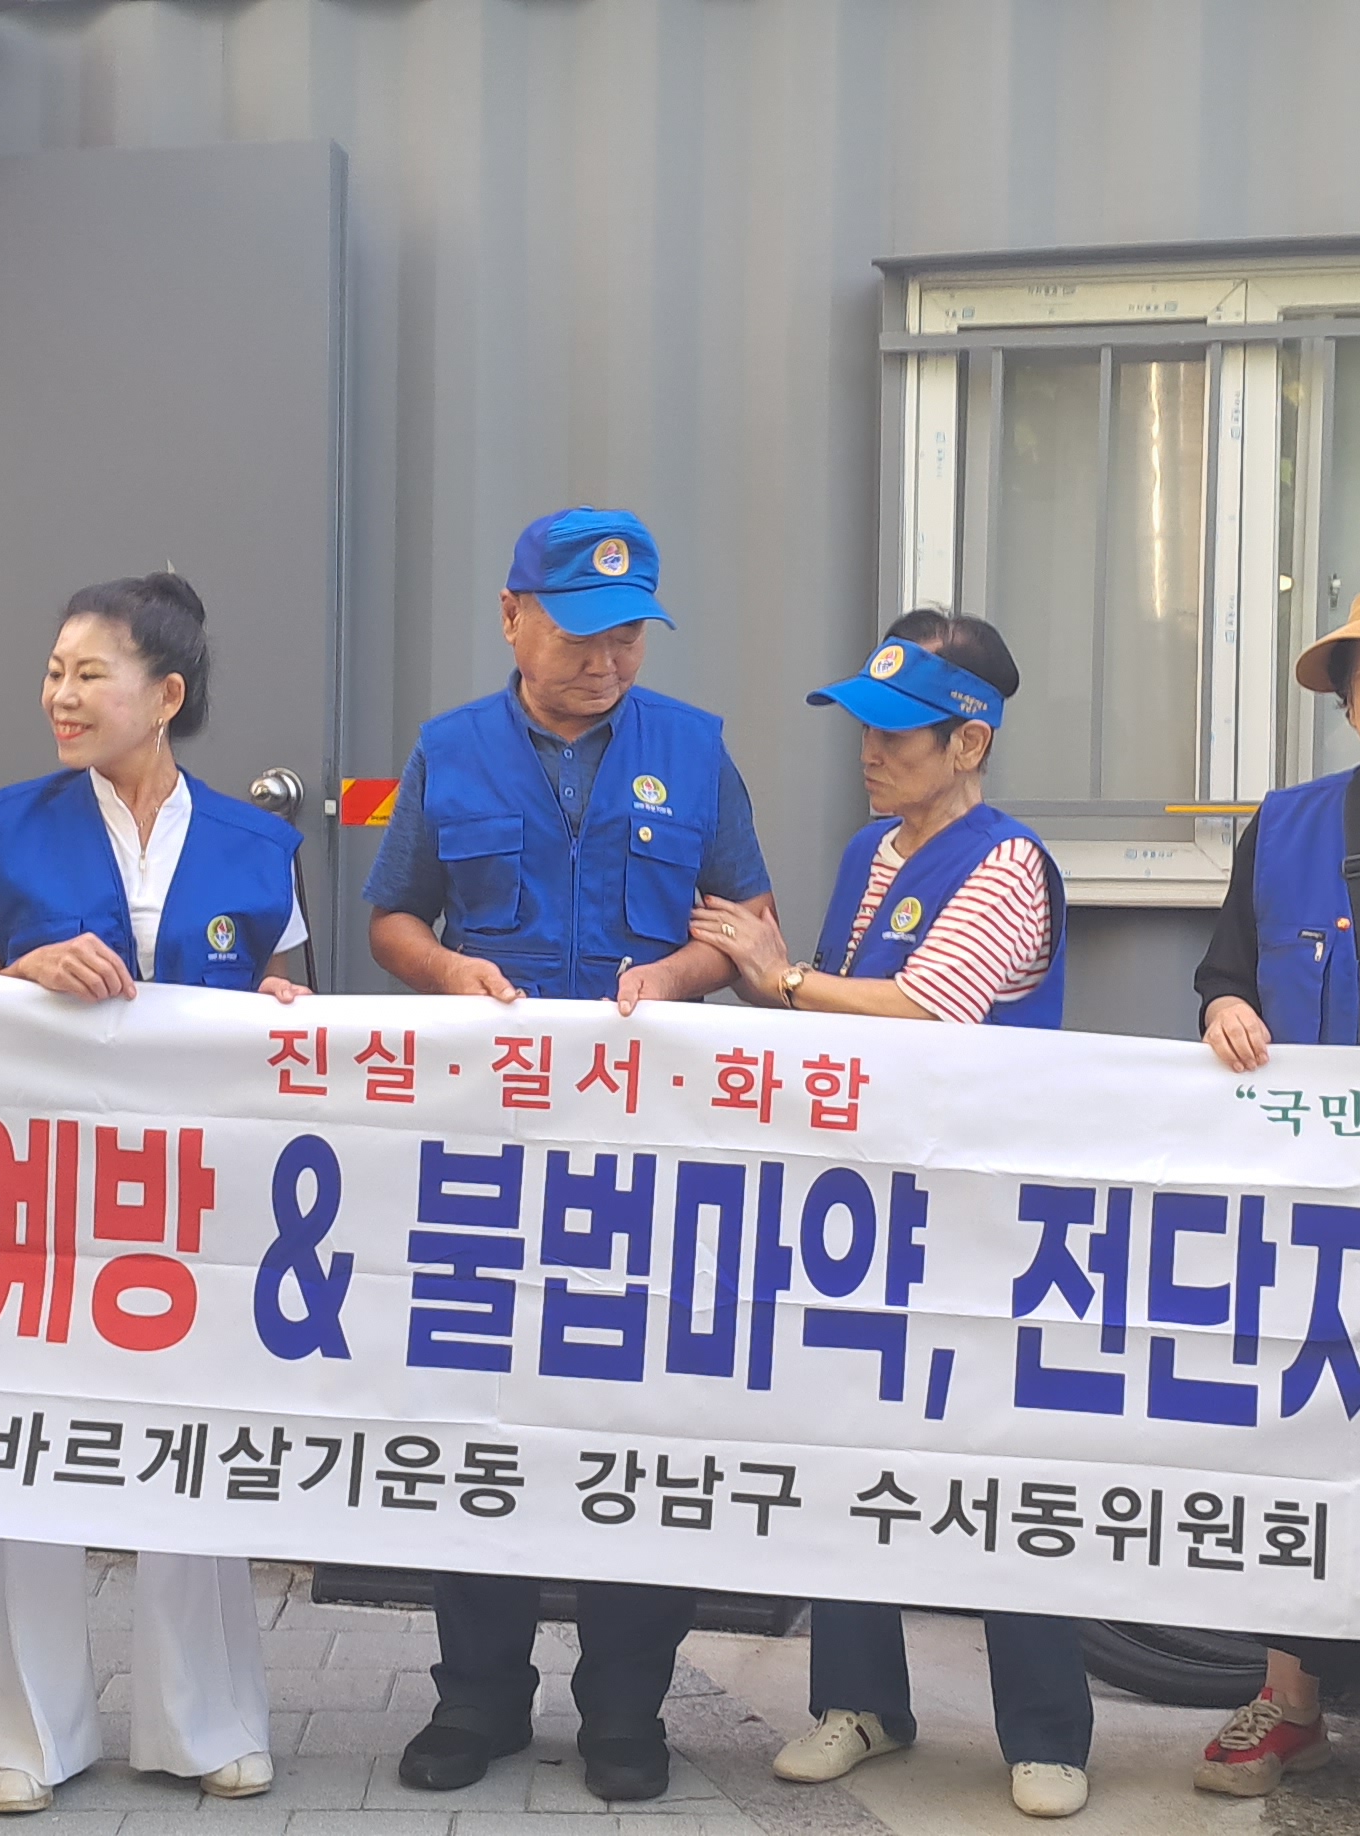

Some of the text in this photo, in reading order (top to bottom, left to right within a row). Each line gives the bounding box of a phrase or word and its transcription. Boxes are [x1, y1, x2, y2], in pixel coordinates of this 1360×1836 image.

[253, 1134, 355, 1361] &
[407, 1140, 955, 1420] 불법마약,
[575, 1449, 802, 1537] 강남구
[849, 1470, 1329, 1581] 수서동위원회
